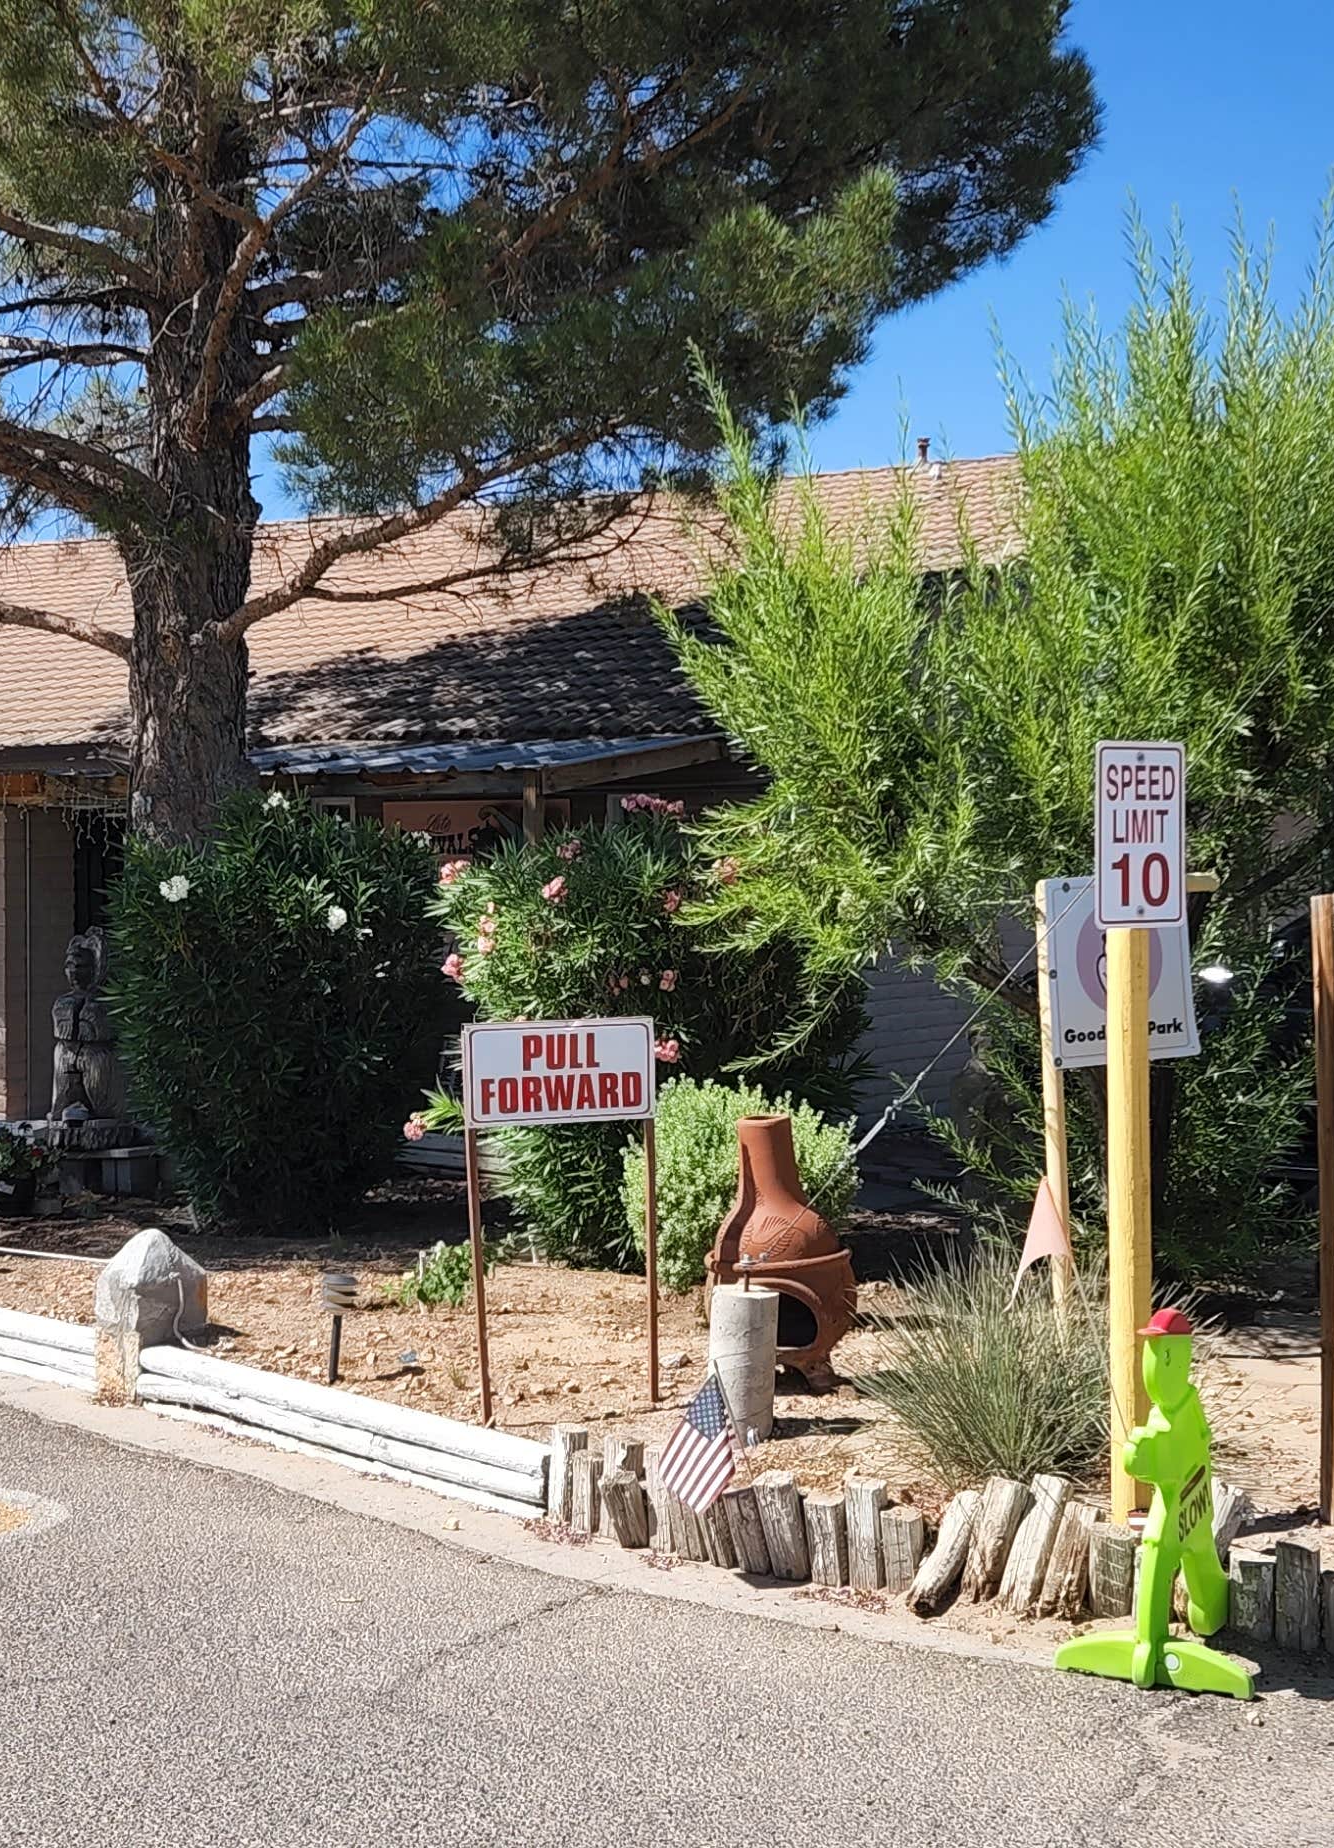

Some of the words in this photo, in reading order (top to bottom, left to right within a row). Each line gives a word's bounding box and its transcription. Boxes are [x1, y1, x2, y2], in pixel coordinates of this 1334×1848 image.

[1106, 764, 1176, 802] SPEED
[1112, 809, 1169, 844] LIMIT
[1111, 852, 1170, 908] 10
[1065, 1024, 1105, 1043] Good
[1147, 1018, 1183, 1035] Park
[522, 1033, 600, 1071] PULL
[481, 1071, 642, 1115] FORWARD
